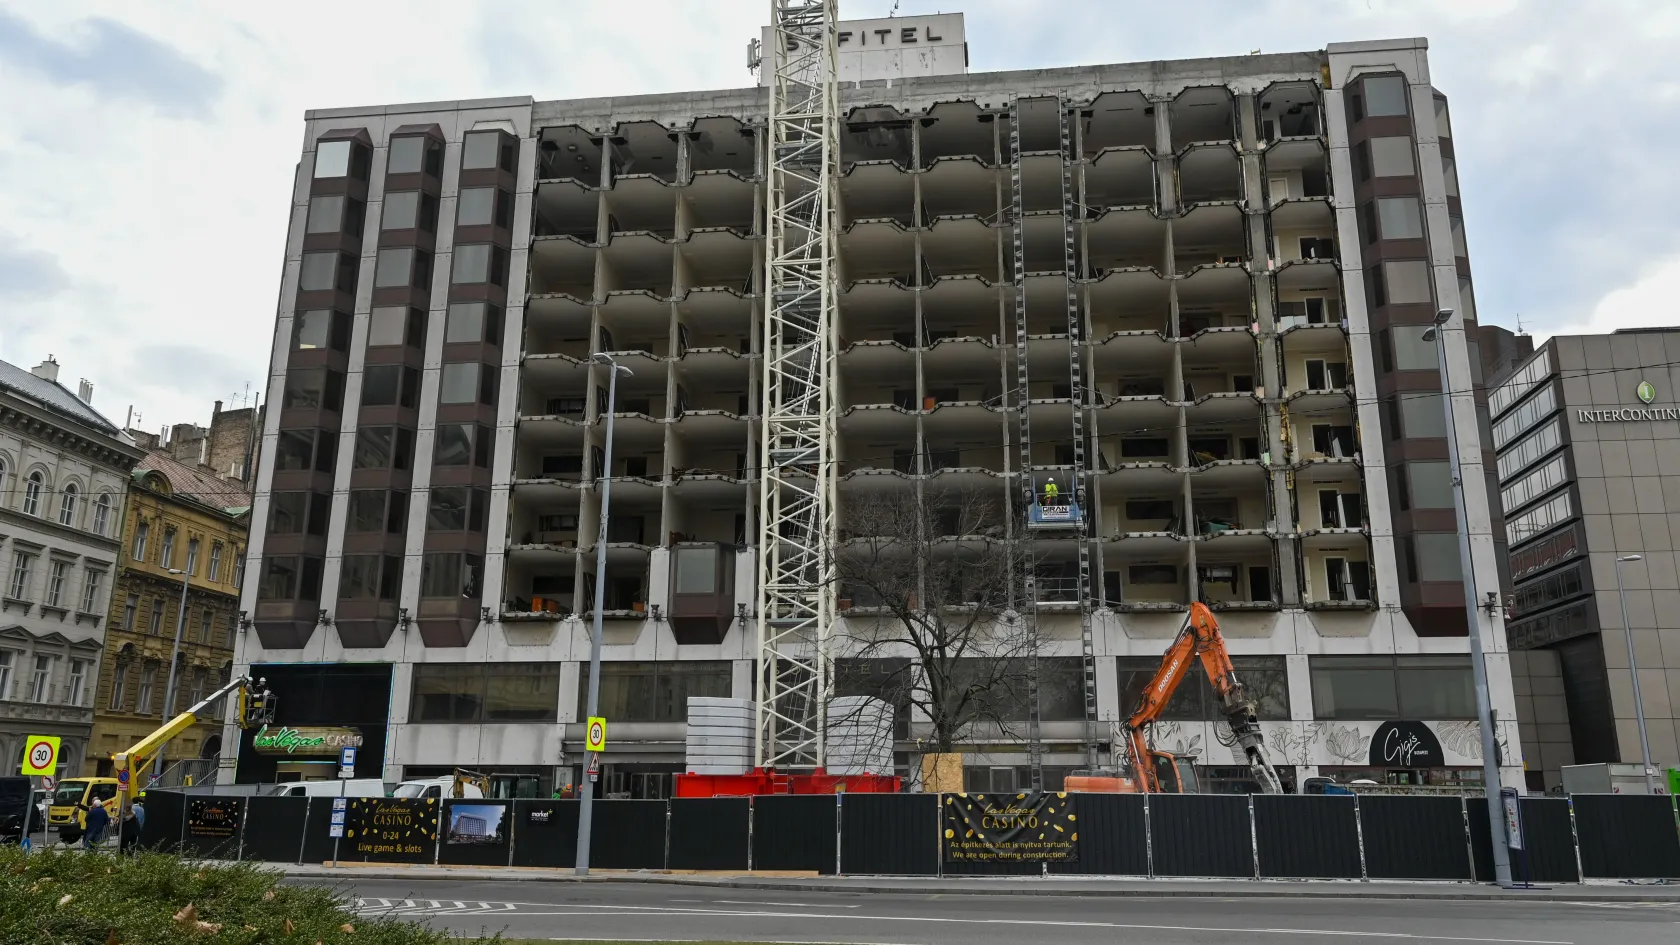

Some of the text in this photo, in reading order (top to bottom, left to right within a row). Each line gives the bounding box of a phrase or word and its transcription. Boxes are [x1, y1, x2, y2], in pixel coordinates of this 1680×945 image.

[1158, 659, 1178, 692] DOOSAN
[592, 729, 600, 738] 30
[35, 750, 47, 761] 30
[373, 815, 412, 825] CASINO
[982, 816, 1038, 829] CASINO
[382, 831, 399, 839] 0-24
[358, 843, 422, 854] Live game & slots
[998, 852, 1021, 860] during
